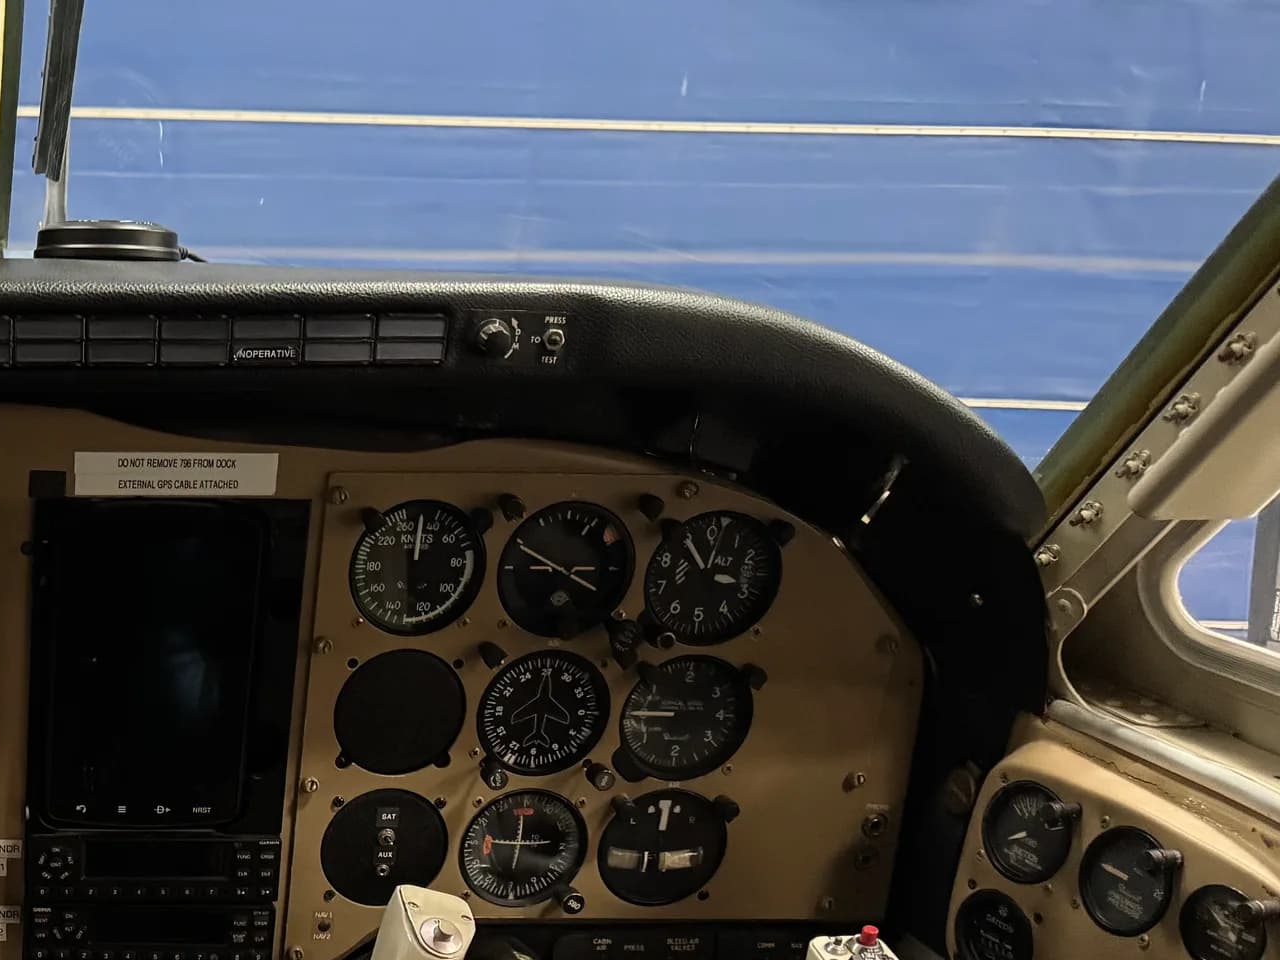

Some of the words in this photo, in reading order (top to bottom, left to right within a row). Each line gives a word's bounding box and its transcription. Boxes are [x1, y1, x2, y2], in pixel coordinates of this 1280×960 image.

[545, 315, 567, 325] PRESS
[117, 458, 130, 470] DO
[130, 458, 145, 470] NOT
[147, 458, 179, 470] REMOVE
[192, 459, 215, 470] FROM
[216, 459, 237, 470] DOCK
[118, 479, 156, 490] EXTERNAL
[157, 479, 173, 490] GPS
[174, 479, 198, 490] CABLE
[199, 479, 239, 490] ATTACHED
[400, 534, 433, 544] KNTS
[441, 534, 456, 544] 60
[450, 557, 463, 568] 80
[439, 583, 455, 593] 100
[416, 601, 431, 612] 120
[192, 806, 213, 814] NRST
